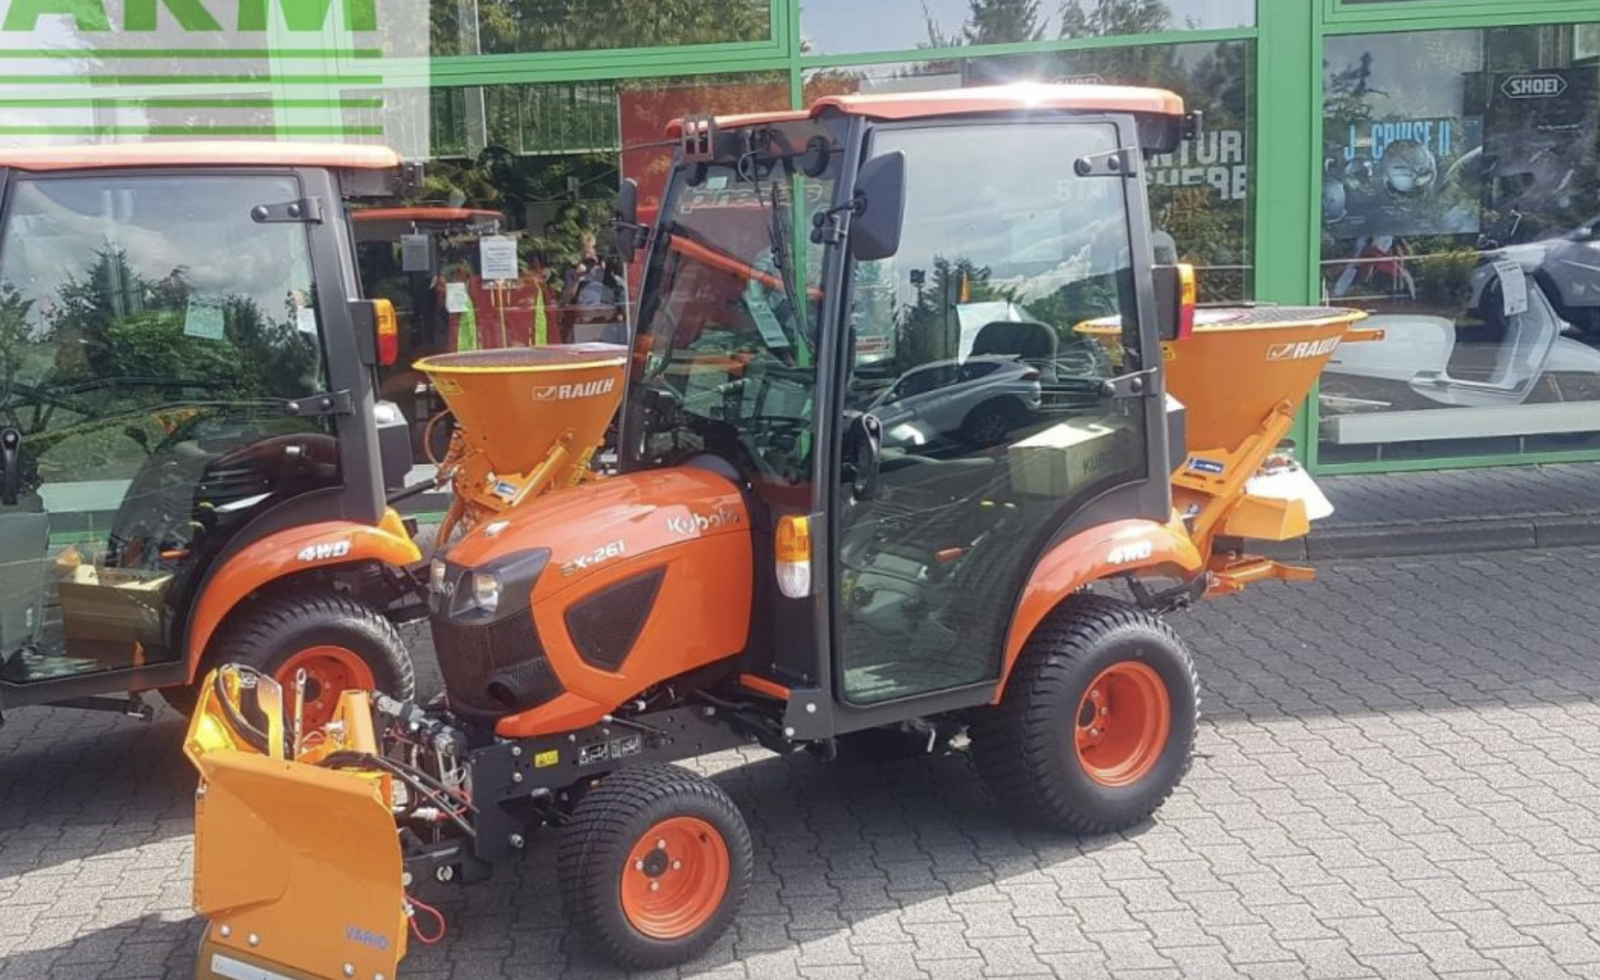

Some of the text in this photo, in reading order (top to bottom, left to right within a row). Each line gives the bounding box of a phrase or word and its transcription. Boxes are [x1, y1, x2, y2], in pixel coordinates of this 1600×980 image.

[1510, 78, 1558, 94] SHOEI
[559, 377, 615, 400] RAUCH
[297, 540, 350, 561] 4WD
